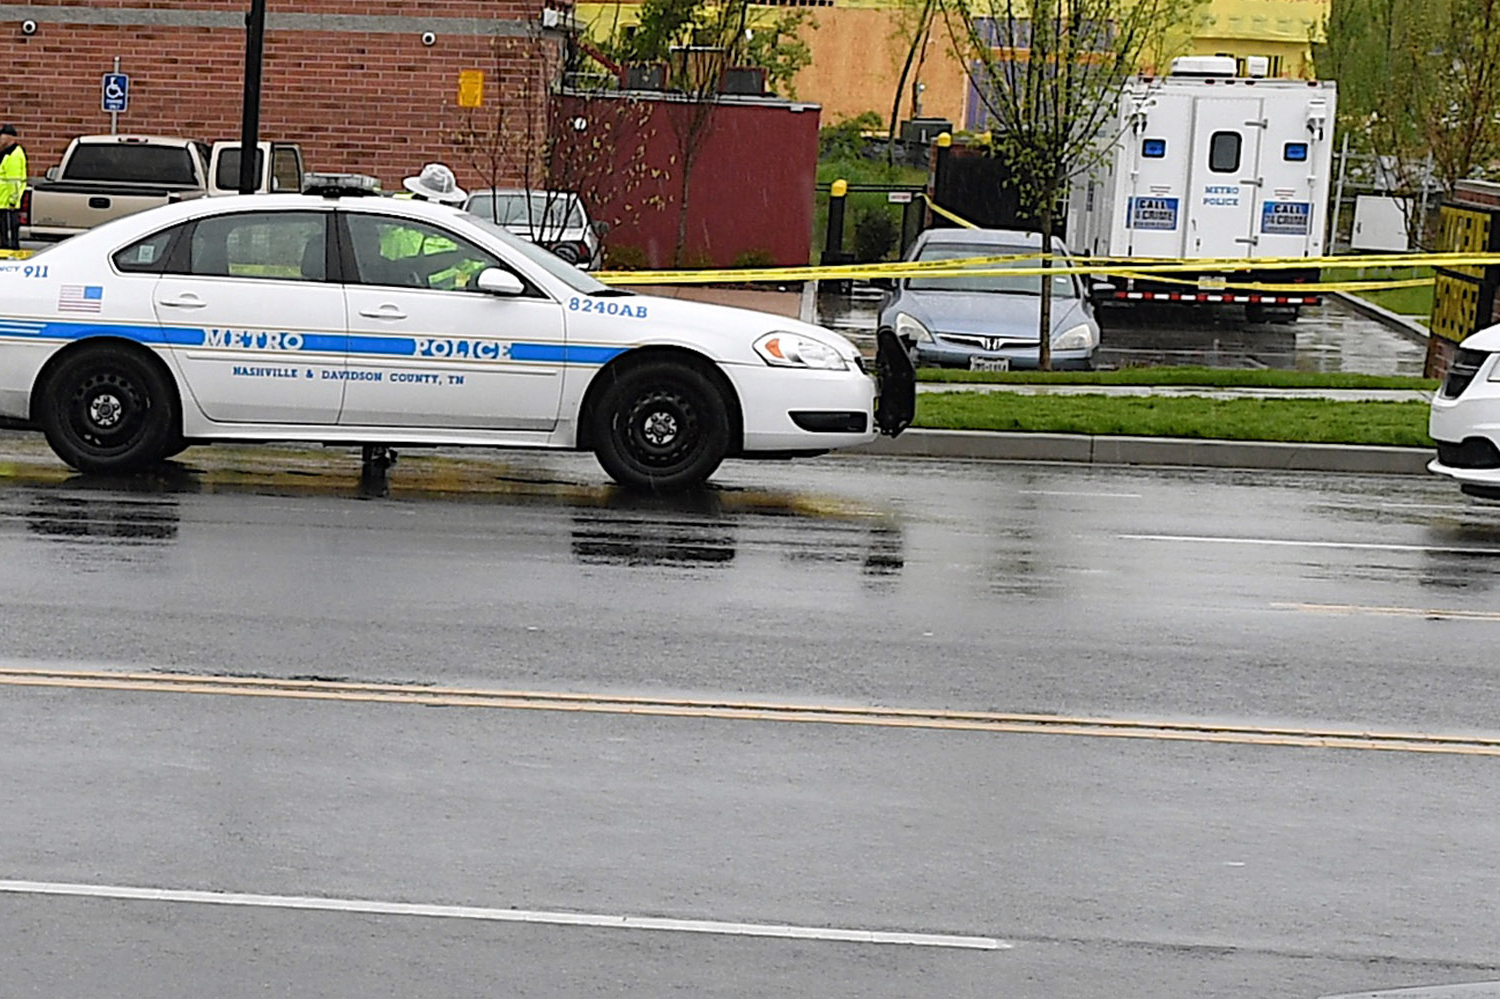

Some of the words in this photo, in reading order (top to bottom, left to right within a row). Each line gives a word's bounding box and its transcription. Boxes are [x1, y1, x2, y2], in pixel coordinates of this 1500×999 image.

[1204, 186, 1239, 194] METRO
[1139, 200, 1167, 209] CALL
[1203, 197, 1239, 206] POLICE
[1274, 204, 1302, 214] CALL
[23, 265, 48, 278] 911
[568, 296, 648, 319] 8240AB
[205, 328, 304, 351] METRO
[414, 337, 513, 361] POLICE
[233, 366, 298, 378] NASHVILLE
[305, 369, 314, 379] &
[321, 370, 382, 381] DAVIDSON
[389, 372, 443, 386] COUNTY,
[448, 375, 464, 385] TN
